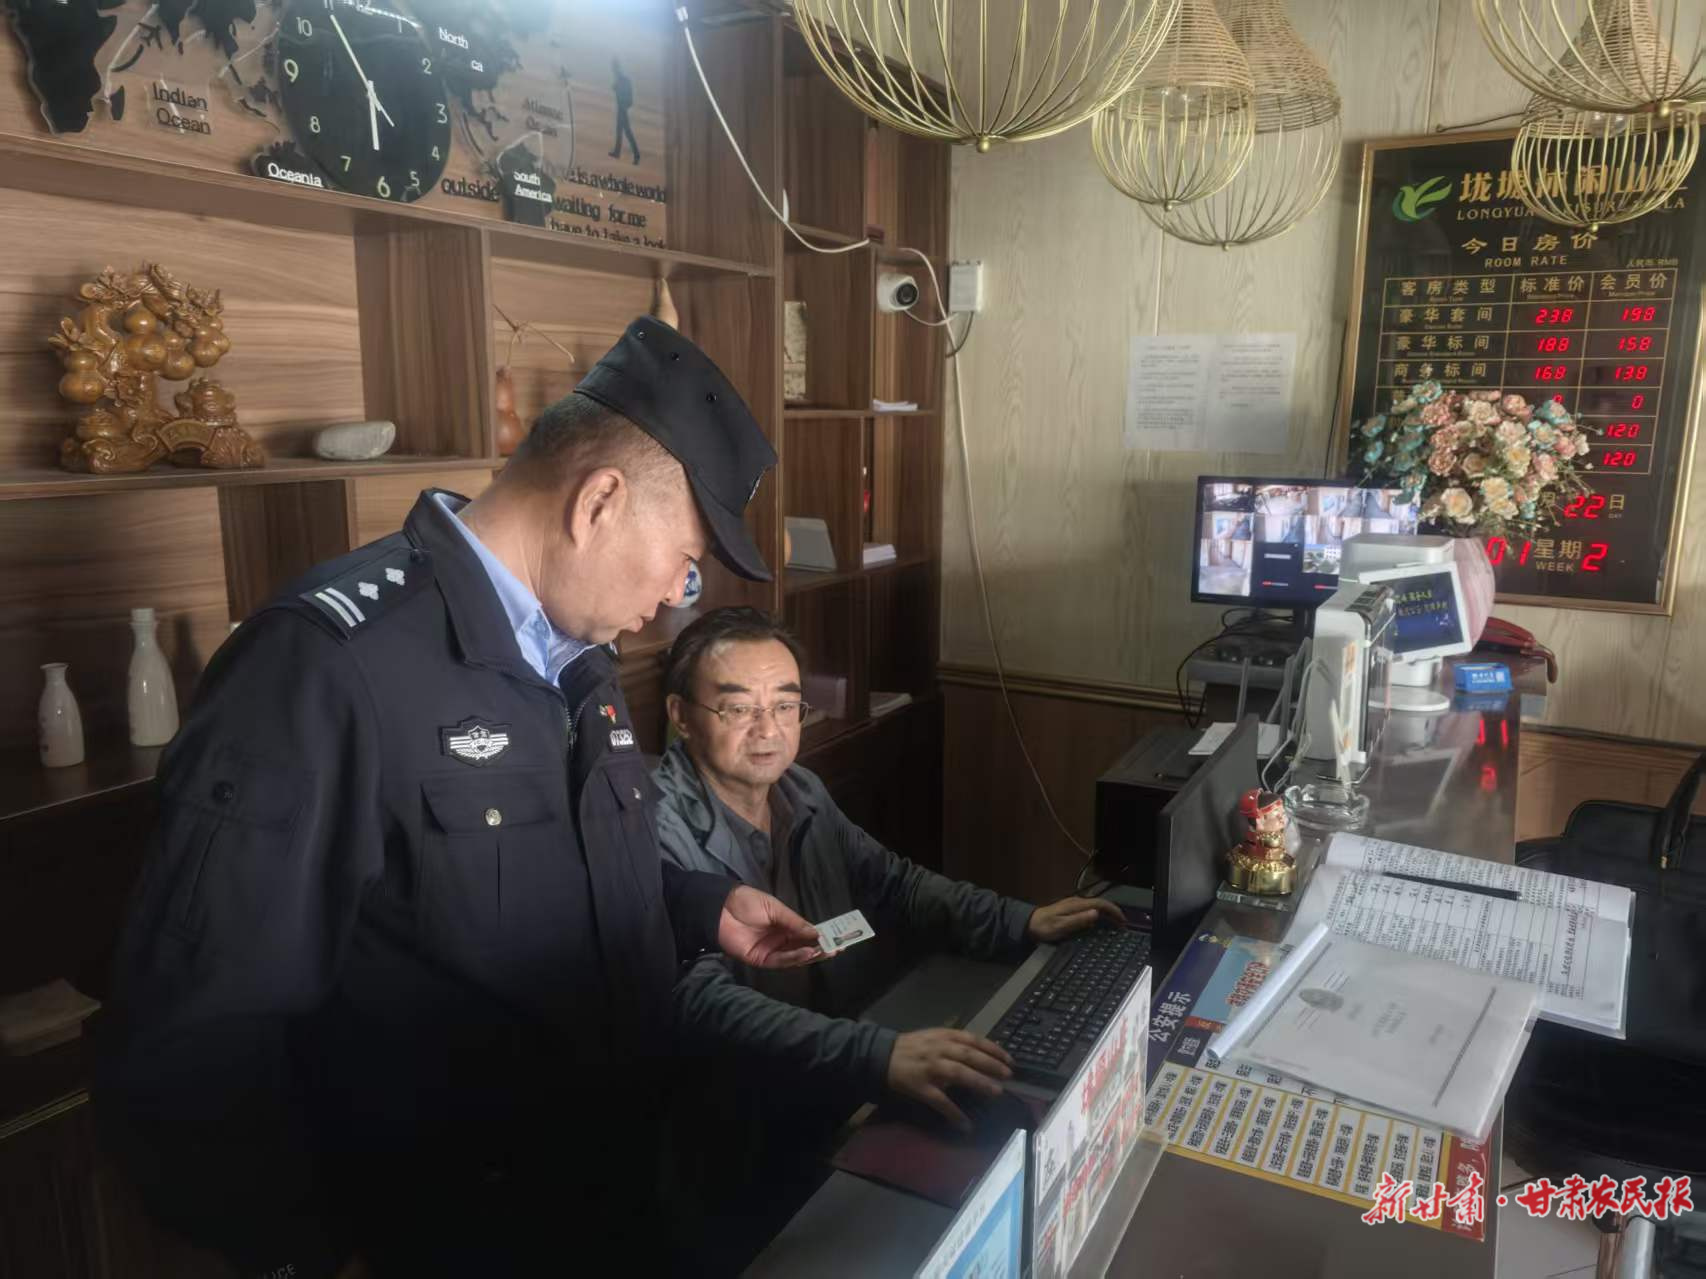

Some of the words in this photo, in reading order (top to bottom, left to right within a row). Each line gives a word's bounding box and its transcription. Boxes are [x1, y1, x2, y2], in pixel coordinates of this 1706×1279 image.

[296, 17, 313, 37] 10
[438, 26, 470, 49] North
[283, 58, 299, 83] 9
[421, 57, 433, 75] 2
[152, 81, 208, 112] Indian
[156, 107, 213, 135] Ocean
[435, 102, 448, 125] 3
[309, 115, 321, 134] 8
[340, 155, 352, 172] 7
[431, 146, 441, 162] 4
[267, 162, 324, 188] Oceania
[409, 171, 421, 188] 5
[513, 171, 541, 187] South
[376, 176, 391, 198] 6
[514, 184, 553, 203] America
[1461, 232, 1599, 255] 今日房价
[1485, 257, 1522, 268] ROOM
[1531, 255, 1568, 266] RATE
[1401, 278, 1496, 297] 客房类型
[1520, 275, 1585, 294] 标准价
[1600, 272, 1668, 291] 会员价
[1535, 308, 1574, 324] 238
[1621, 307, 1656, 322] 198
[1537, 336, 1570, 352] 188
[1617, 336, 1652, 351] 158
[1534, 366, 1567, 381] 168
[1614, 365, 1648, 381] 138
[1631, 394, 1644, 409] 0
[1606, 423, 1640, 439] 120
[1603, 451, 1637, 467] 120
[1563, 495, 1606, 519] 22
[1609, 494, 1625, 511] 日
[1534, 538, 1582, 560] 星期
[1580, 543, 1610, 571] 2
[1535, 561, 1575, 572] WEEK
[1148, 991, 1191, 1042] 公安提示
